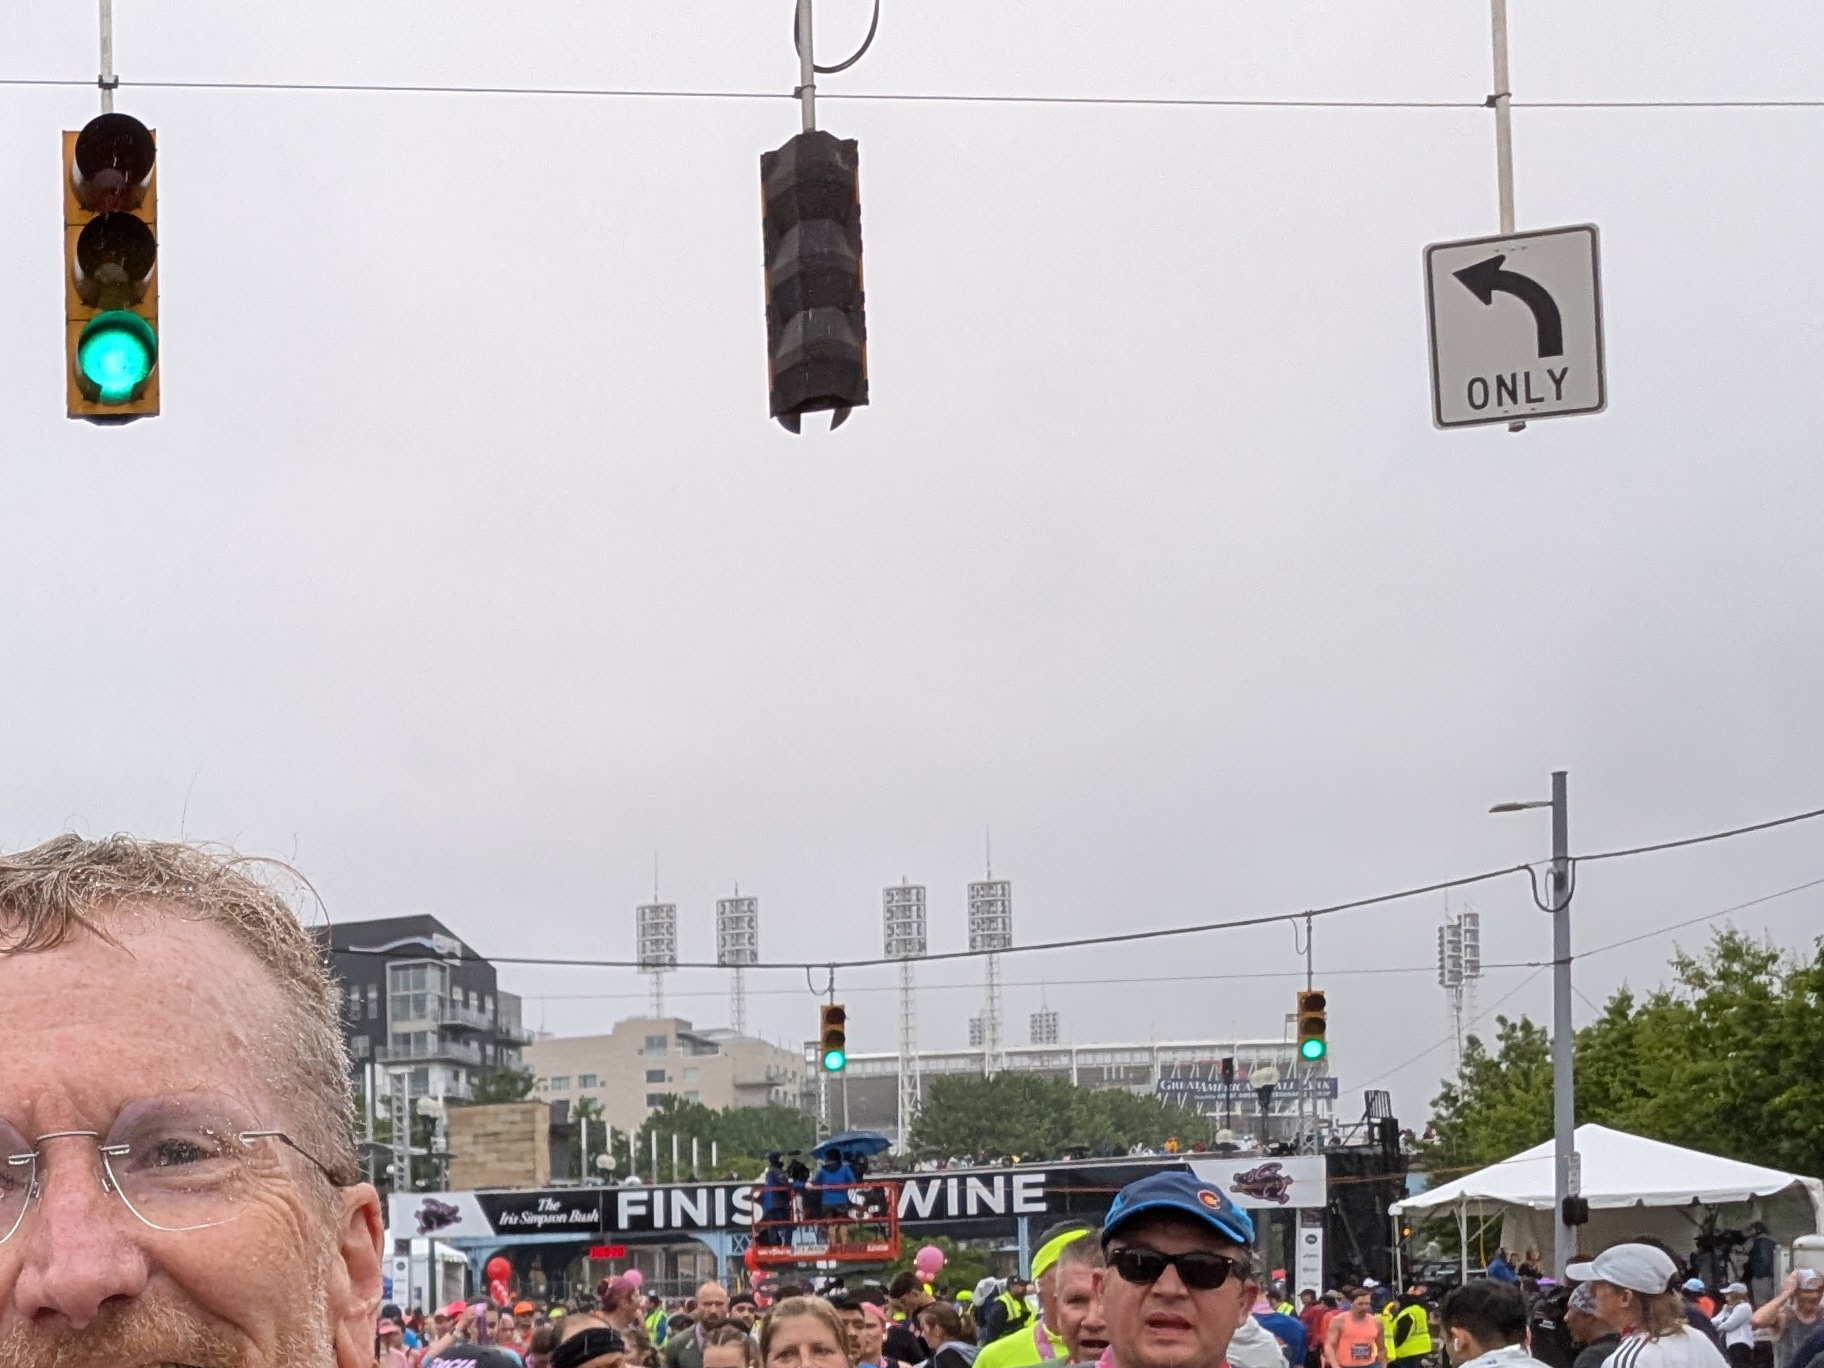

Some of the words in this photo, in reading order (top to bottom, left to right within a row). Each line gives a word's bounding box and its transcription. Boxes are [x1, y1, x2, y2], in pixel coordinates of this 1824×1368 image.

[1467, 367, 1568, 410] ONLY
[499, 1211, 519, 1226] Iris
[519, 1210, 567, 1228] Simpson
[569, 1208, 599, 1223] Bush
[538, 1198, 561, 1211] The
[617, 1186, 764, 1230] FINIS
